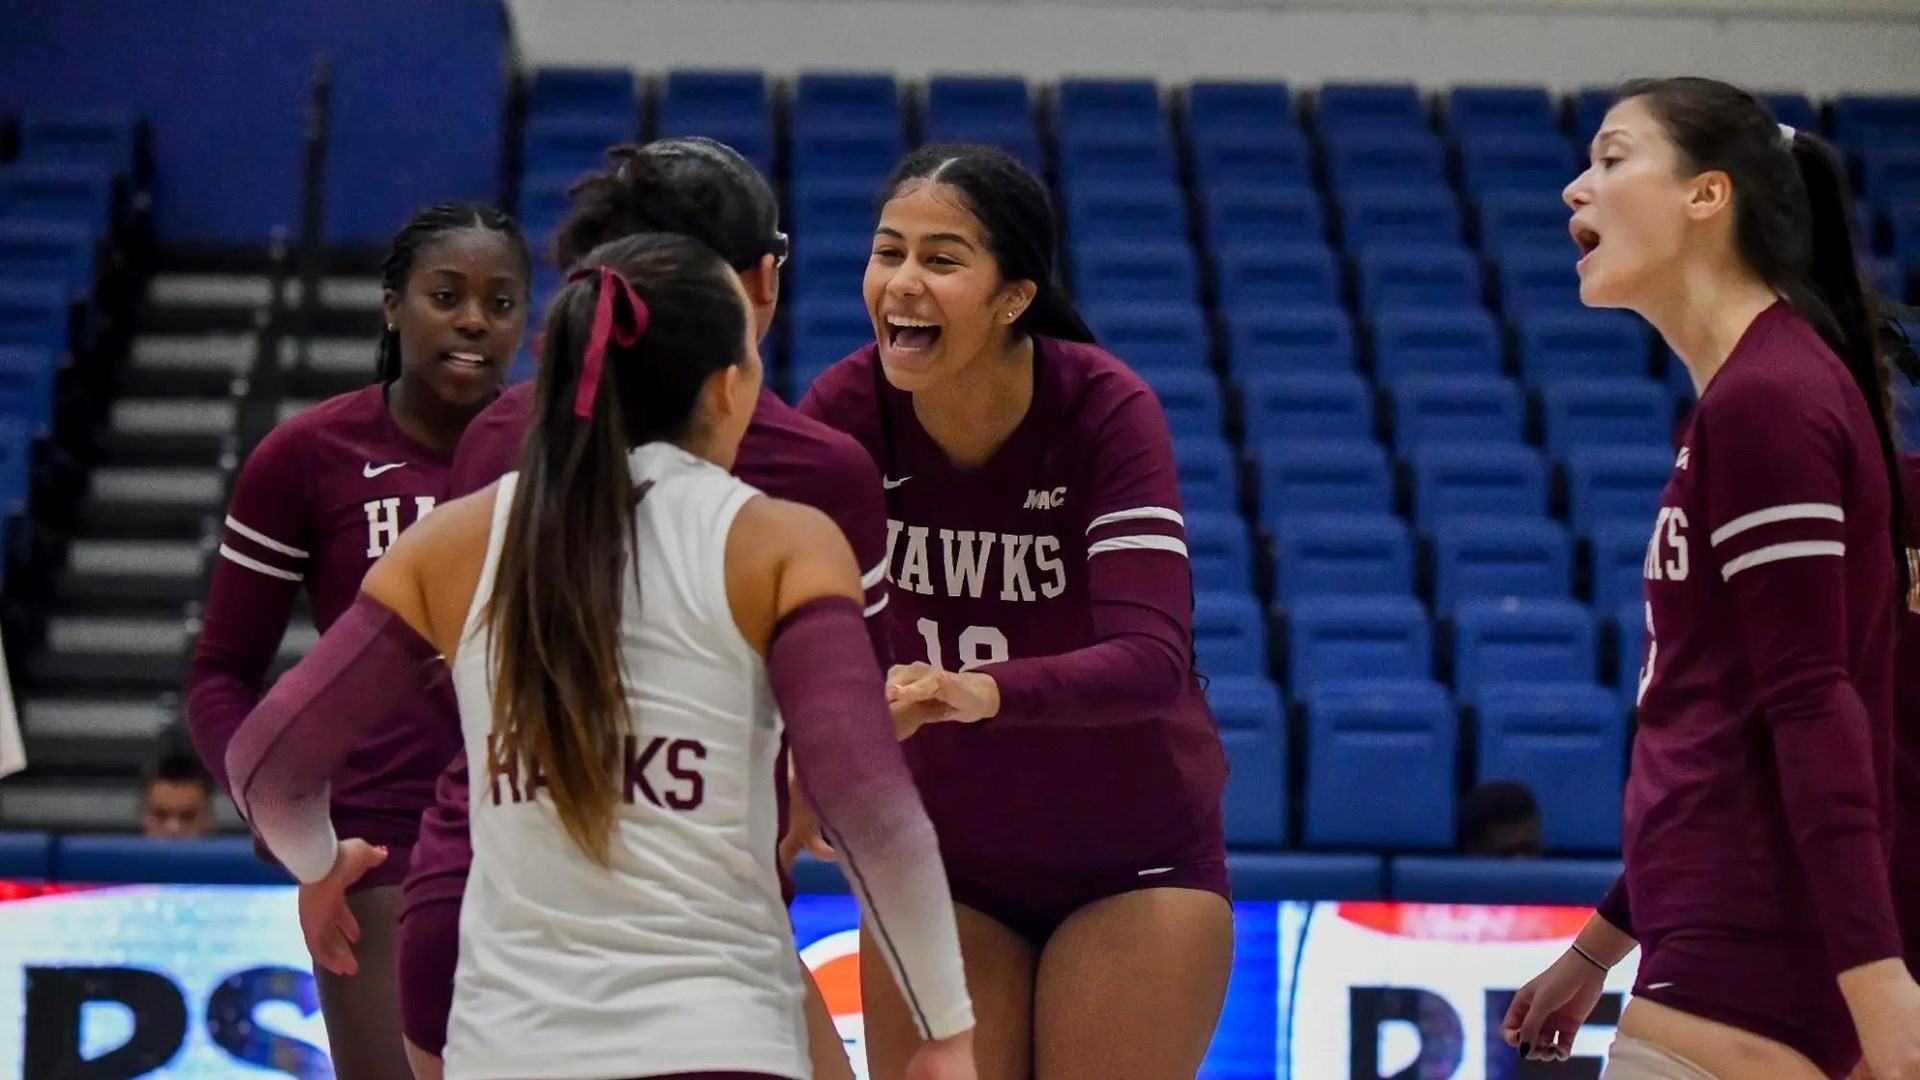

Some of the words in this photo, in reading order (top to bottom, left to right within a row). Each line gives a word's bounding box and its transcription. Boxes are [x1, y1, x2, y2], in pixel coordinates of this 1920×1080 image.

[363, 496, 436, 558] H
[1023, 486, 1067, 510] MAC
[486, 734, 707, 811] HAKS
